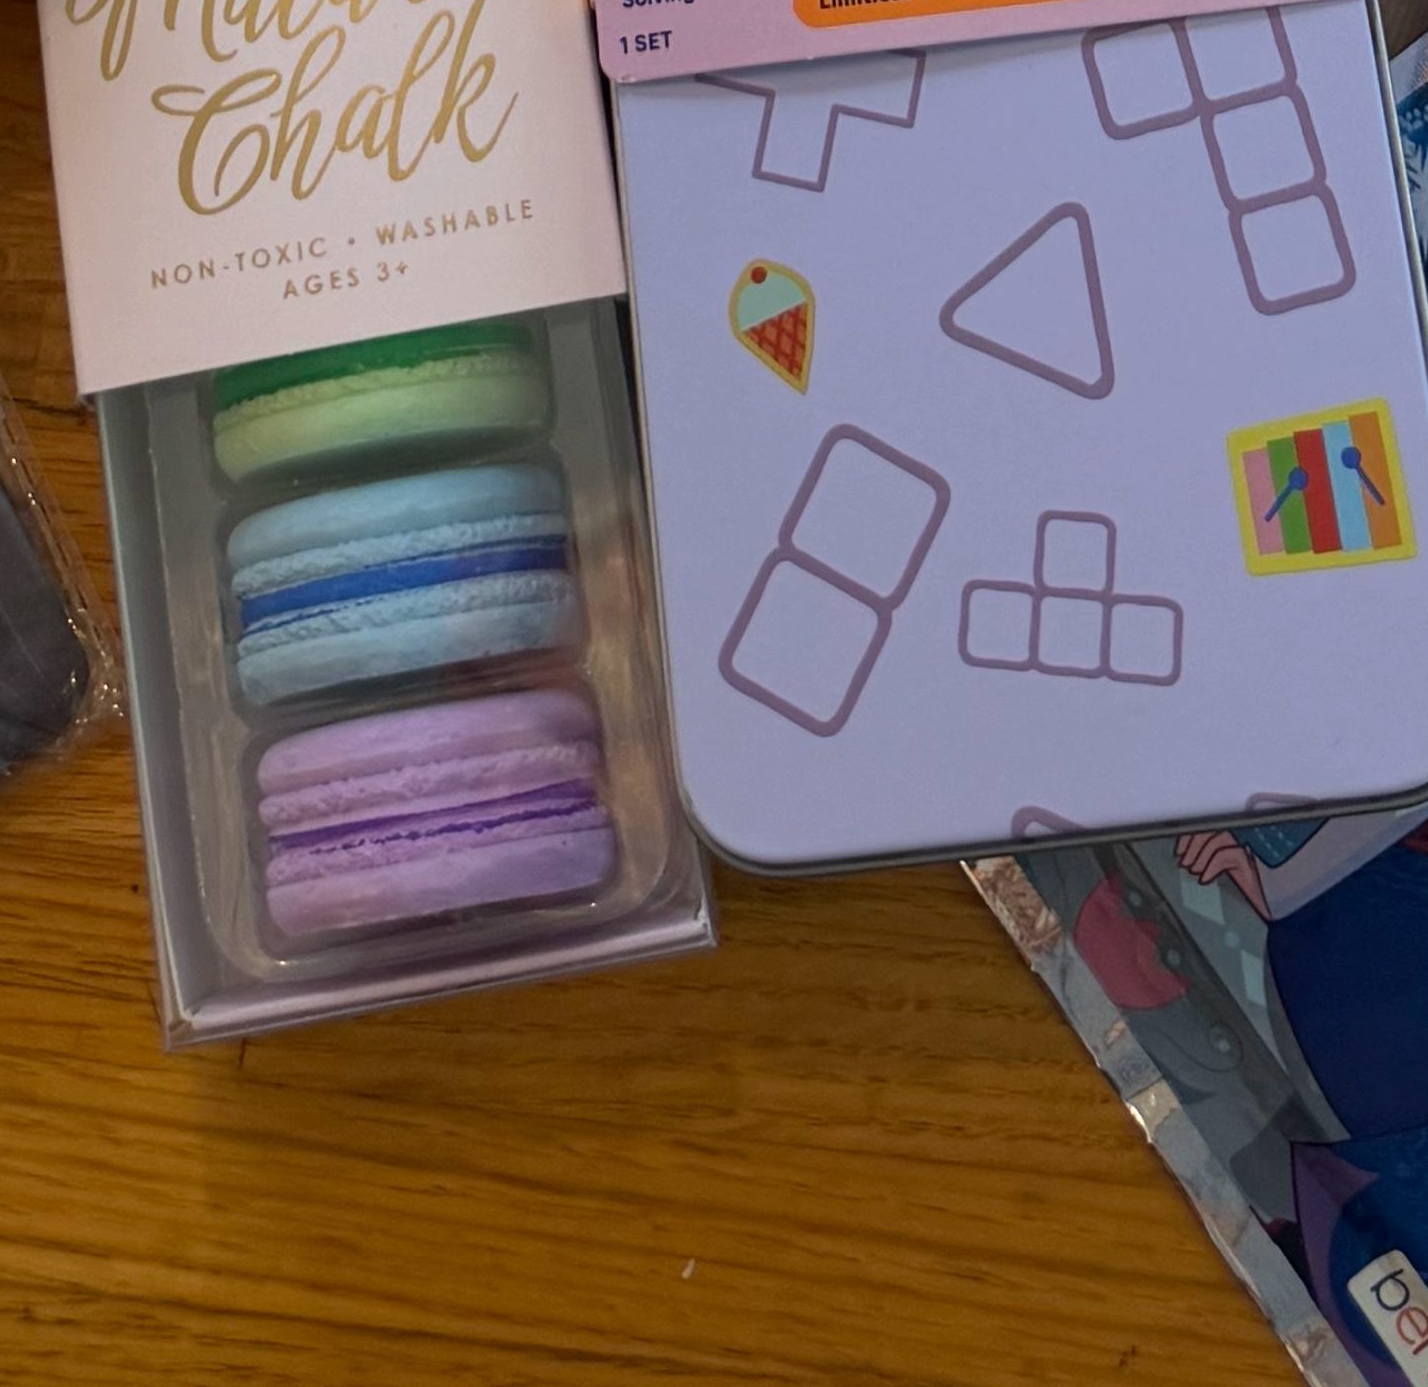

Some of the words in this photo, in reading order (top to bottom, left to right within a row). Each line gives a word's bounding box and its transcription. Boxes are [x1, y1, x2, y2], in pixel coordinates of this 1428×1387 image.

[618, 37, 629, 56] 1
[633, 30, 674, 54] SET
[150, 236, 329, 290] NON-TOXIC
[375, 198, 536, 246] WASHABLE
[281, 267, 362, 300] AGES
[376, 260, 410, 282] 3+
